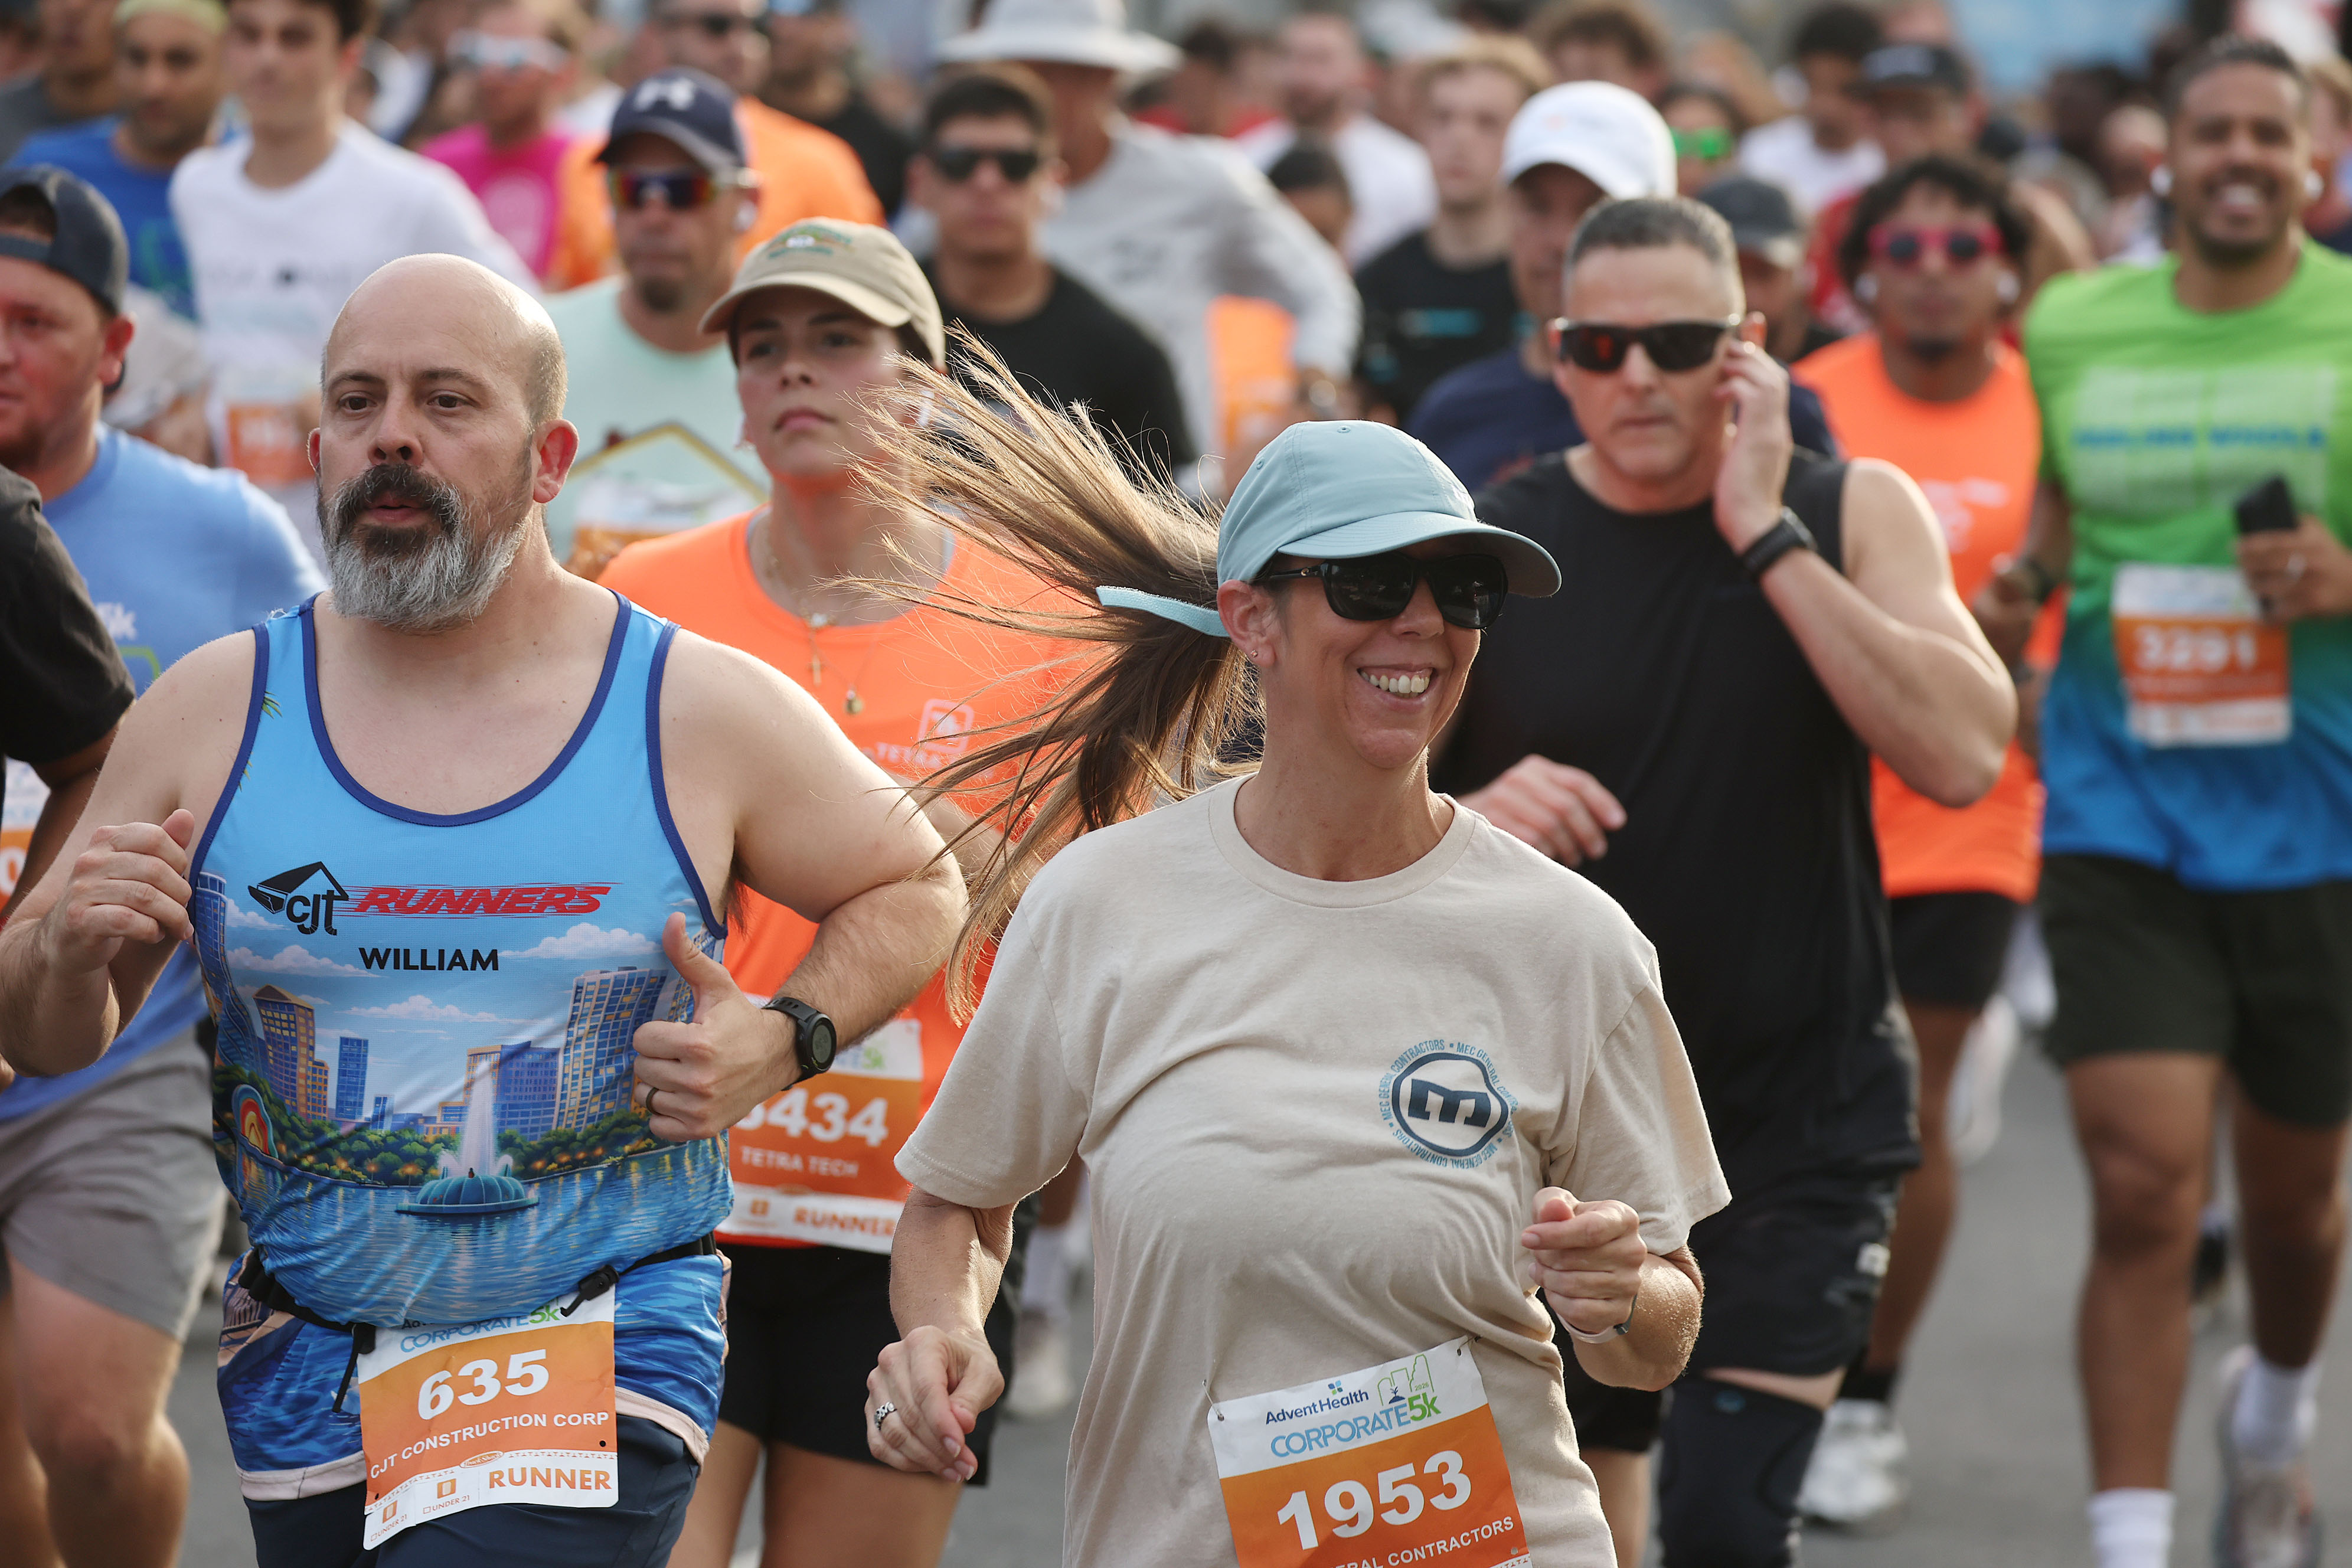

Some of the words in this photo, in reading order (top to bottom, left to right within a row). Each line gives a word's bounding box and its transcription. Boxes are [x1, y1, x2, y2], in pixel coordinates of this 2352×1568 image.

[355, 886, 612, 915] RUNNERS
[358, 948, 499, 971] WILLIAM
[1390, 1039, 1445, 1076] CONTRACTORS
[1456, 1042, 1475, 1055] MEC
[1476, 1049, 1500, 1087] GENERAL
[740, 1146, 803, 1172] TETRA
[808, 1155, 860, 1178] TECH
[1392, 1129, 1448, 1168] CONTRACTORS
[1450, 1154, 1482, 1169] GENERAL
[794, 1206, 896, 1236] RUNNER
[418, 1349, 549, 1420] 635
[370, 1453, 398, 1479] CJT
[401, 1413, 547, 1461] CONSTRUCTION
[553, 1412, 609, 1426] CORP
[489, 1467, 612, 1491] RUNNER
[432, 1498, 460, 1511] UNDER
[1277, 1450, 1472, 1551] 1953
[377, 1518, 400, 1537] UNDER
[400, 1514, 407, 1522] 21
[1387, 1516, 1514, 1567] CONTRACTORS
